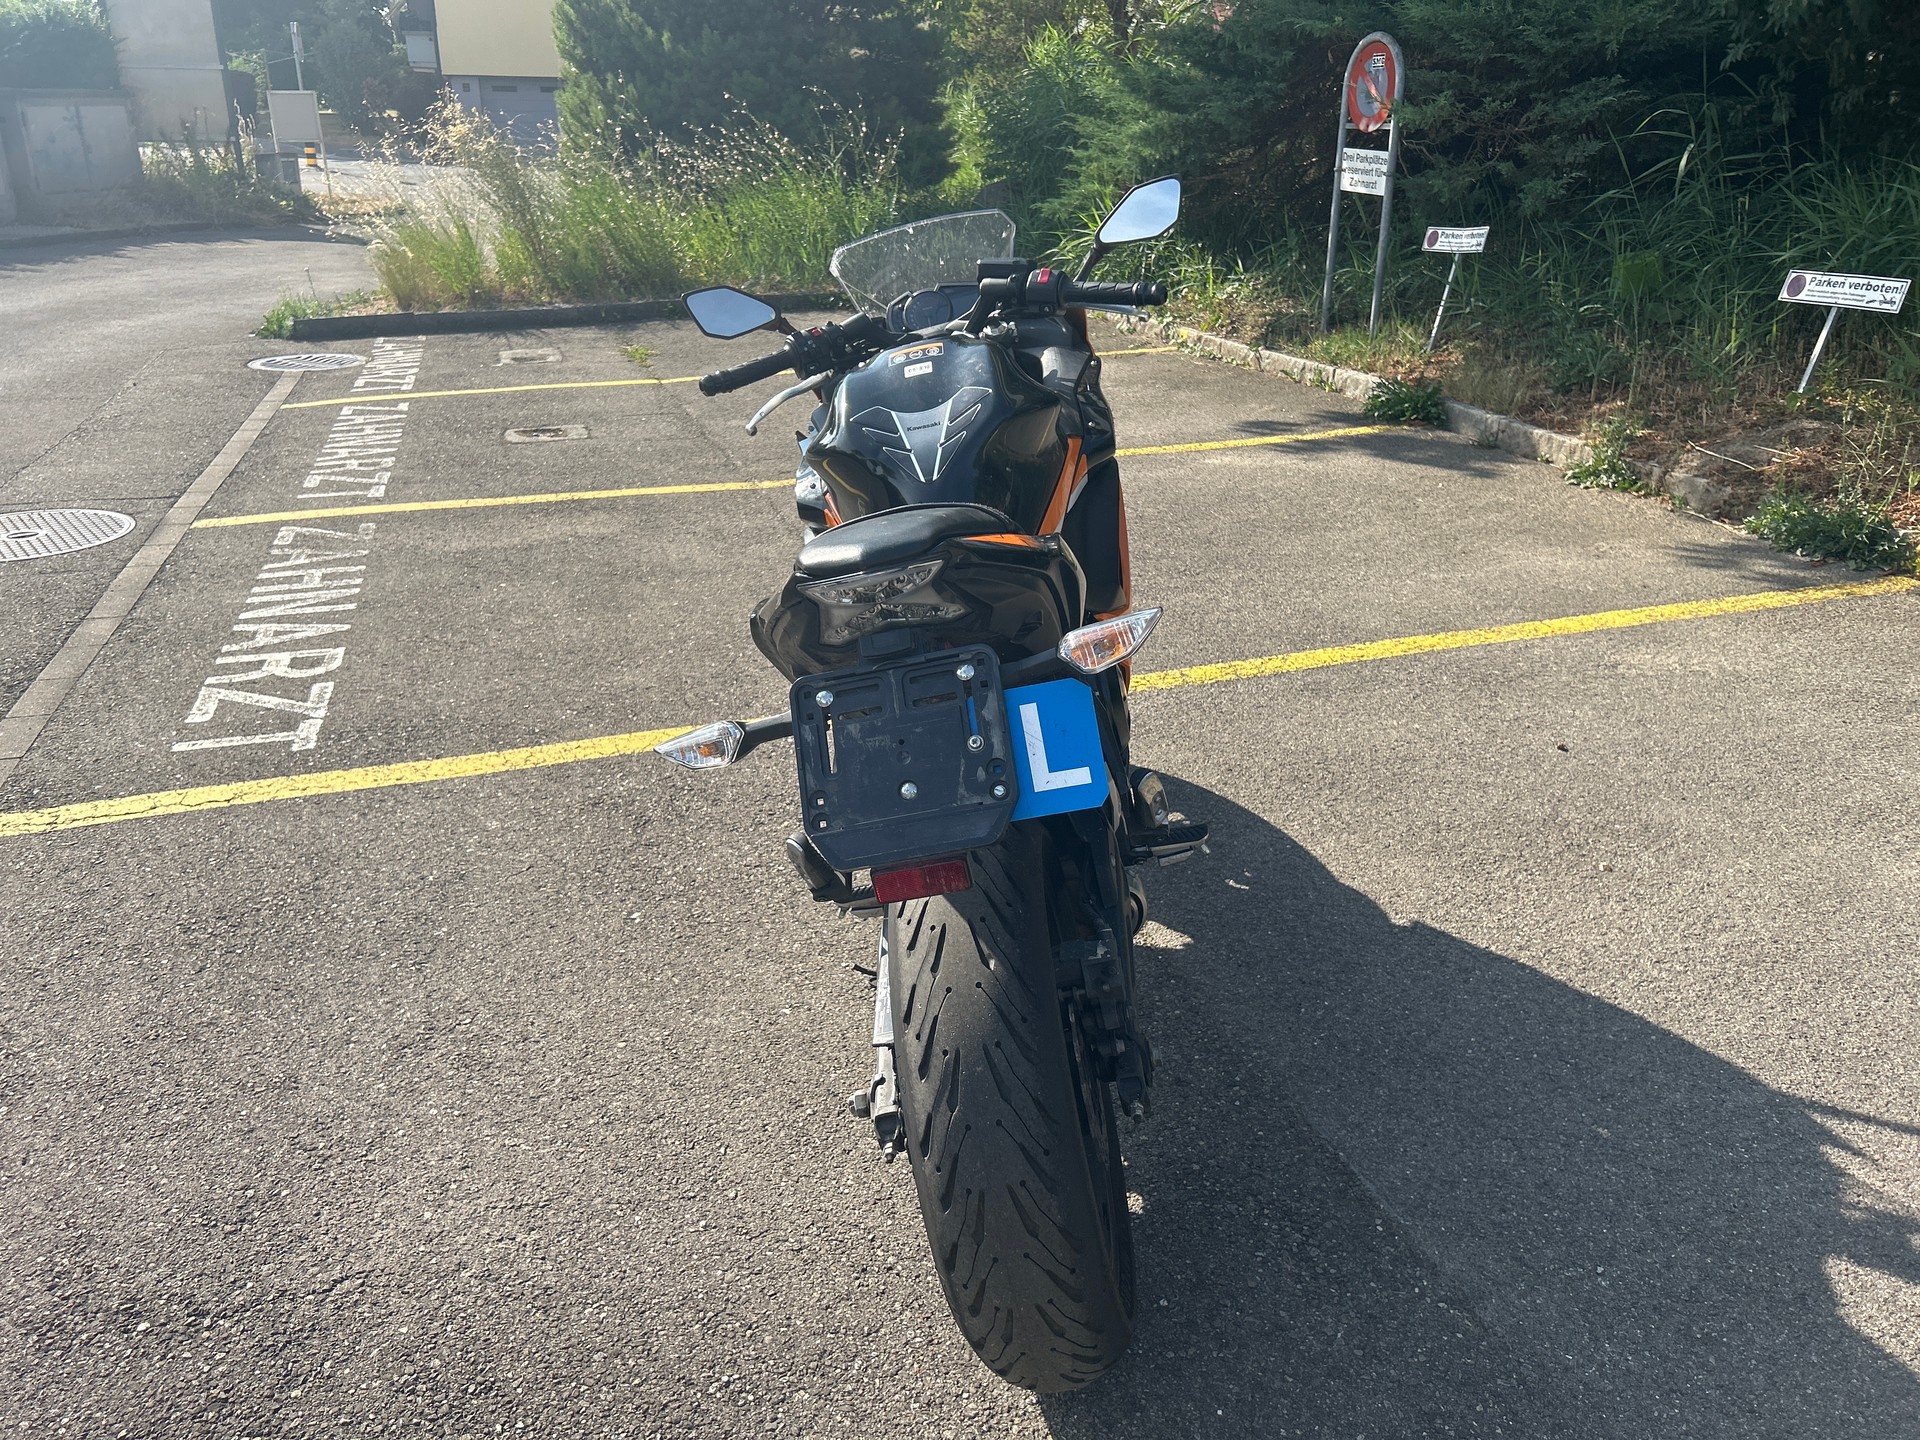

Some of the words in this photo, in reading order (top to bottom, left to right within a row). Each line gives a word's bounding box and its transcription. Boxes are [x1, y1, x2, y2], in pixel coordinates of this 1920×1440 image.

[1343, 152, 1355, 162] Drei
[1356, 153, 1388, 166] Parkplätze
[1440, 231, 1463, 240] Parken
[1808, 276, 1846, 289] Parken
[1848, 280, 1904, 295] verboten!
[350, 335, 427, 392] ZAHNARZT
[906, 420, 942, 432] Kawasaki
[297, 402, 410, 499] ZAHNARZT
[170, 522, 376, 752] ZAHNARZT
[1019, 702, 1093, 793] L
